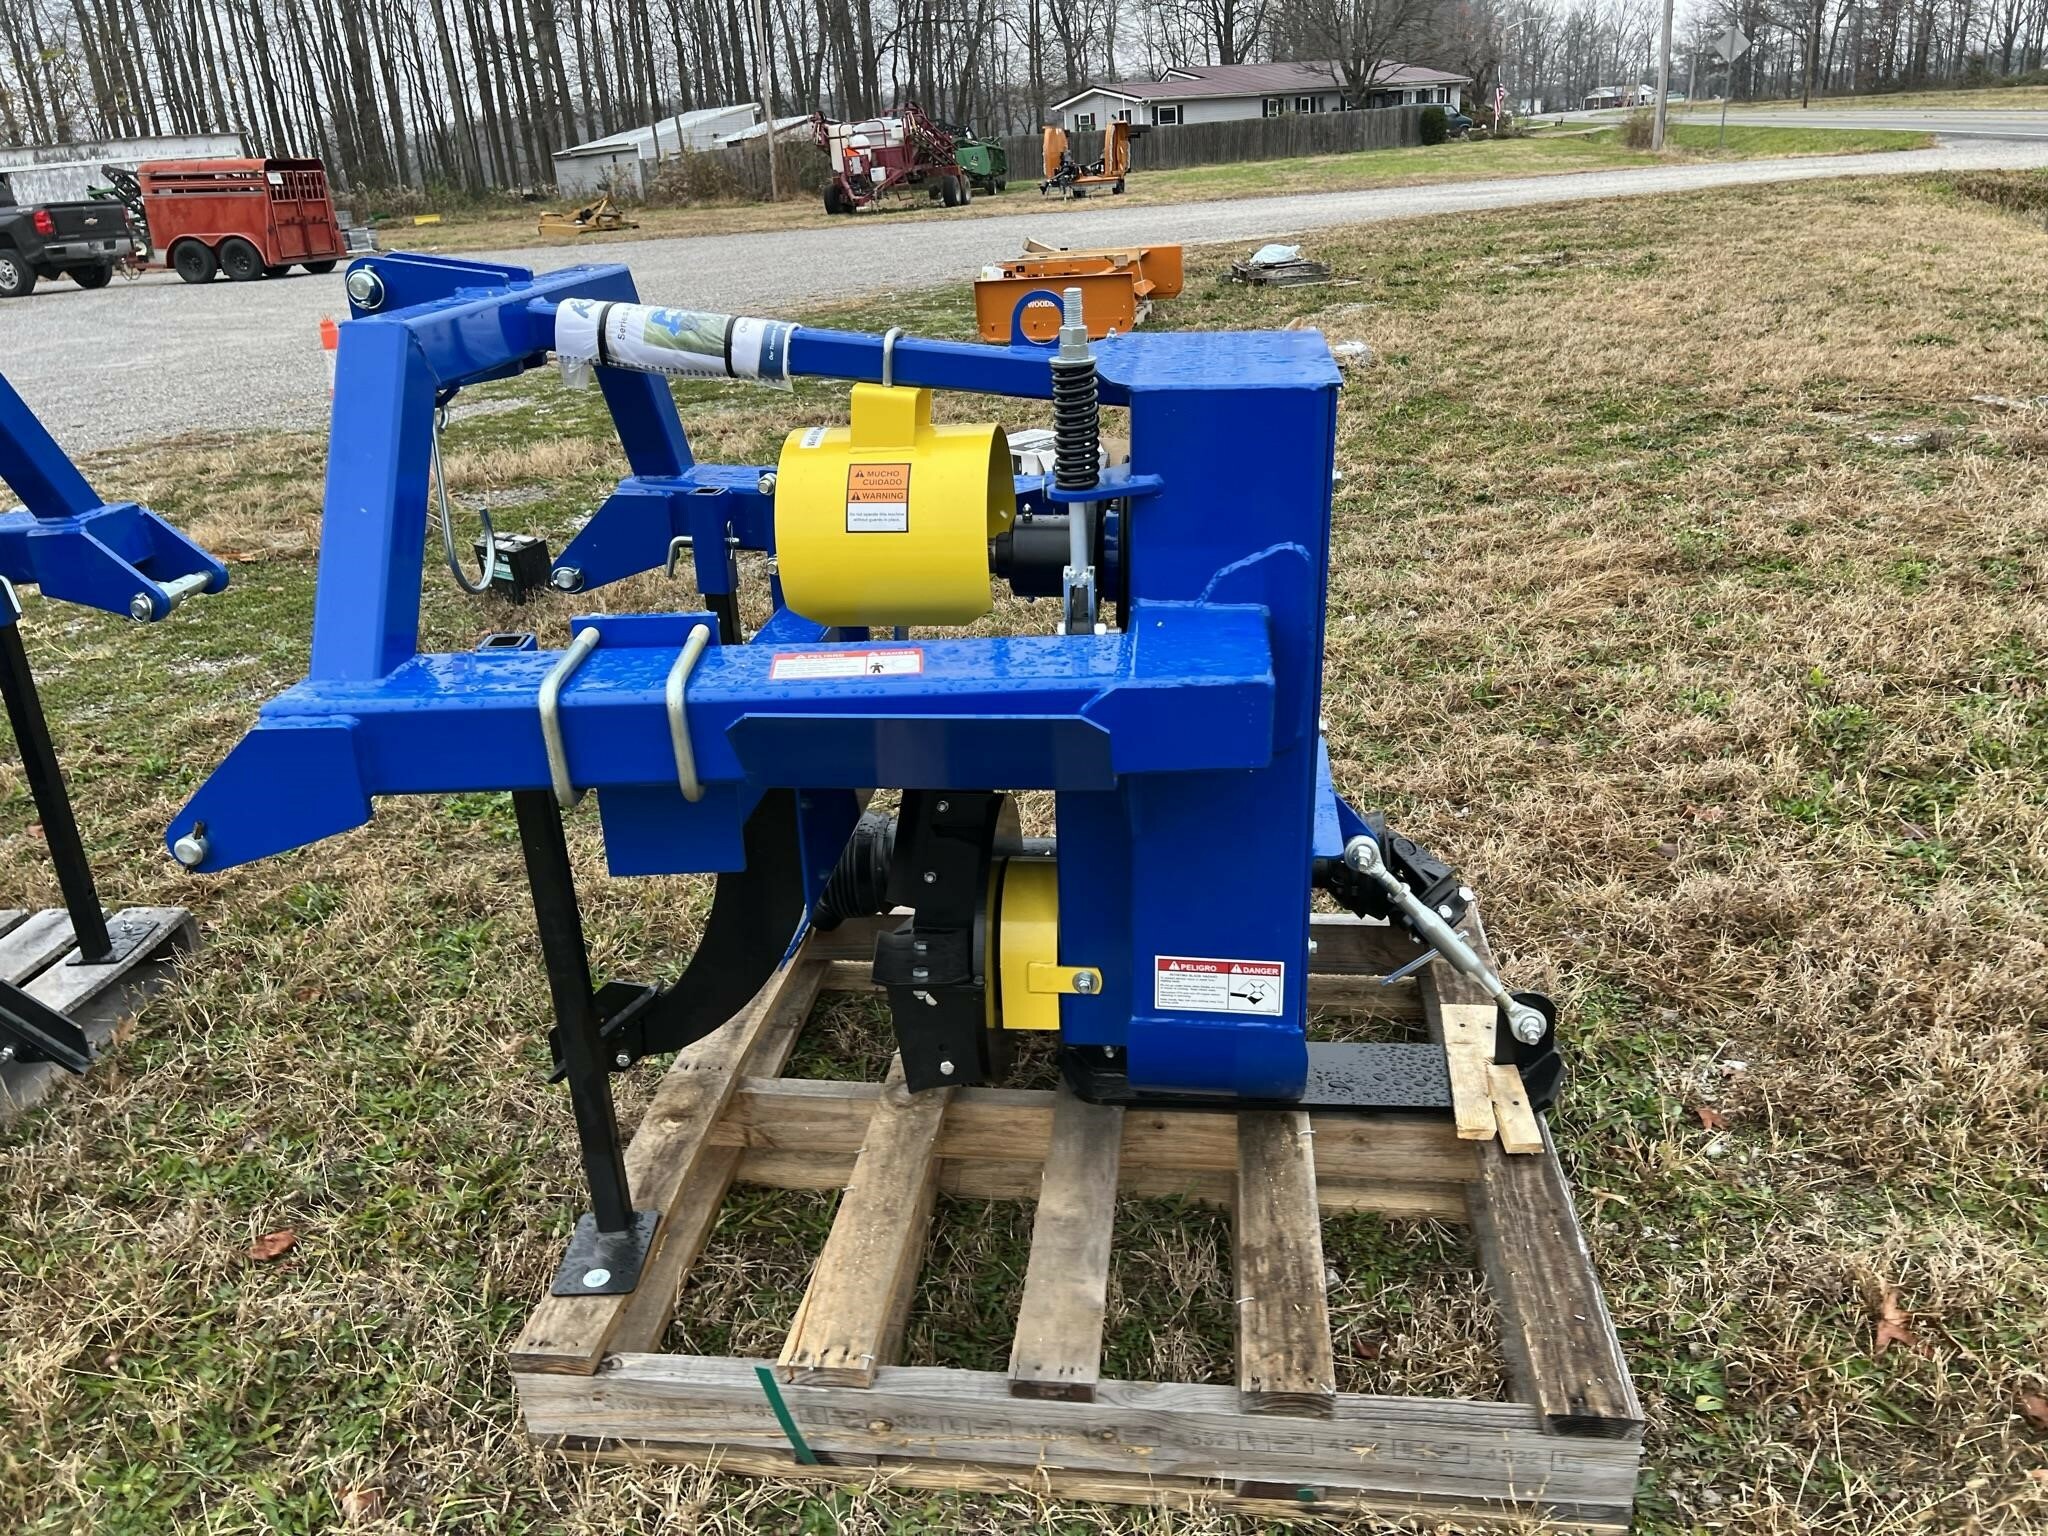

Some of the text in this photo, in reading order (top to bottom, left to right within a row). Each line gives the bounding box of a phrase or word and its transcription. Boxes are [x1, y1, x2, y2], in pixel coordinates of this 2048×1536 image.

[862, 492, 904, 500] WARNING
[1180, 963, 1217, 972] PELIGRO
[1243, 966, 1279, 975] DANGER
